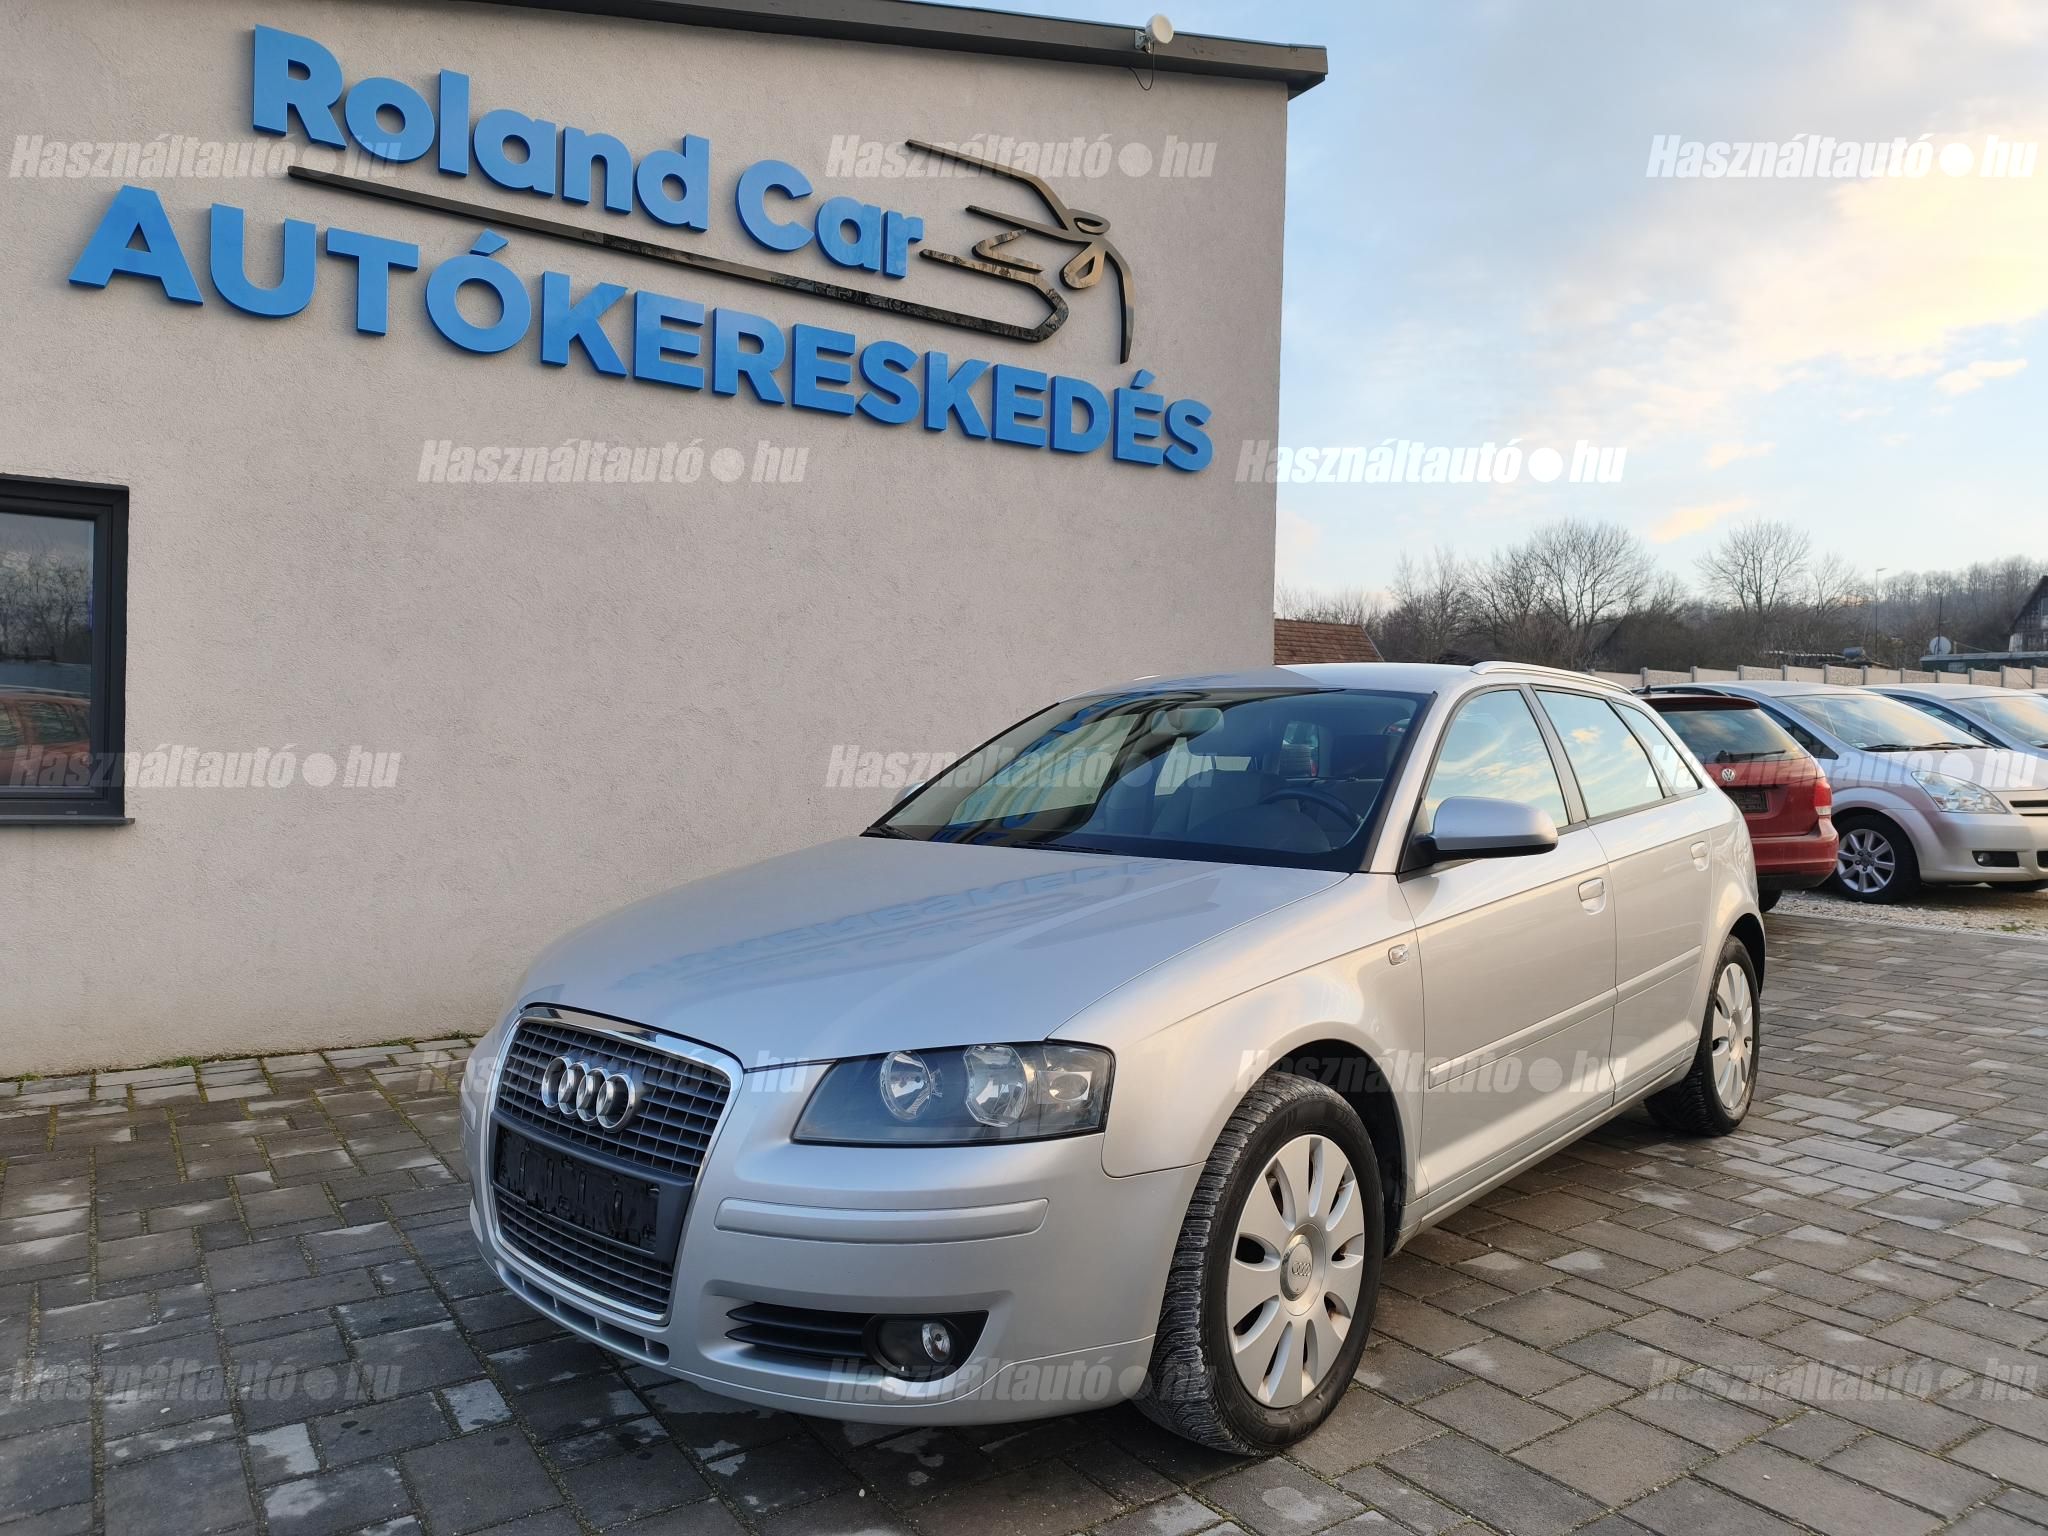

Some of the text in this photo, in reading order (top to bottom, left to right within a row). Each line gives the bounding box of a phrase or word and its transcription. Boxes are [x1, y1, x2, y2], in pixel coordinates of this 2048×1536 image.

[252, 24, 925, 279] Roland Car
[68, 184, 1214, 473] AUTÓKERESKEDÉS
